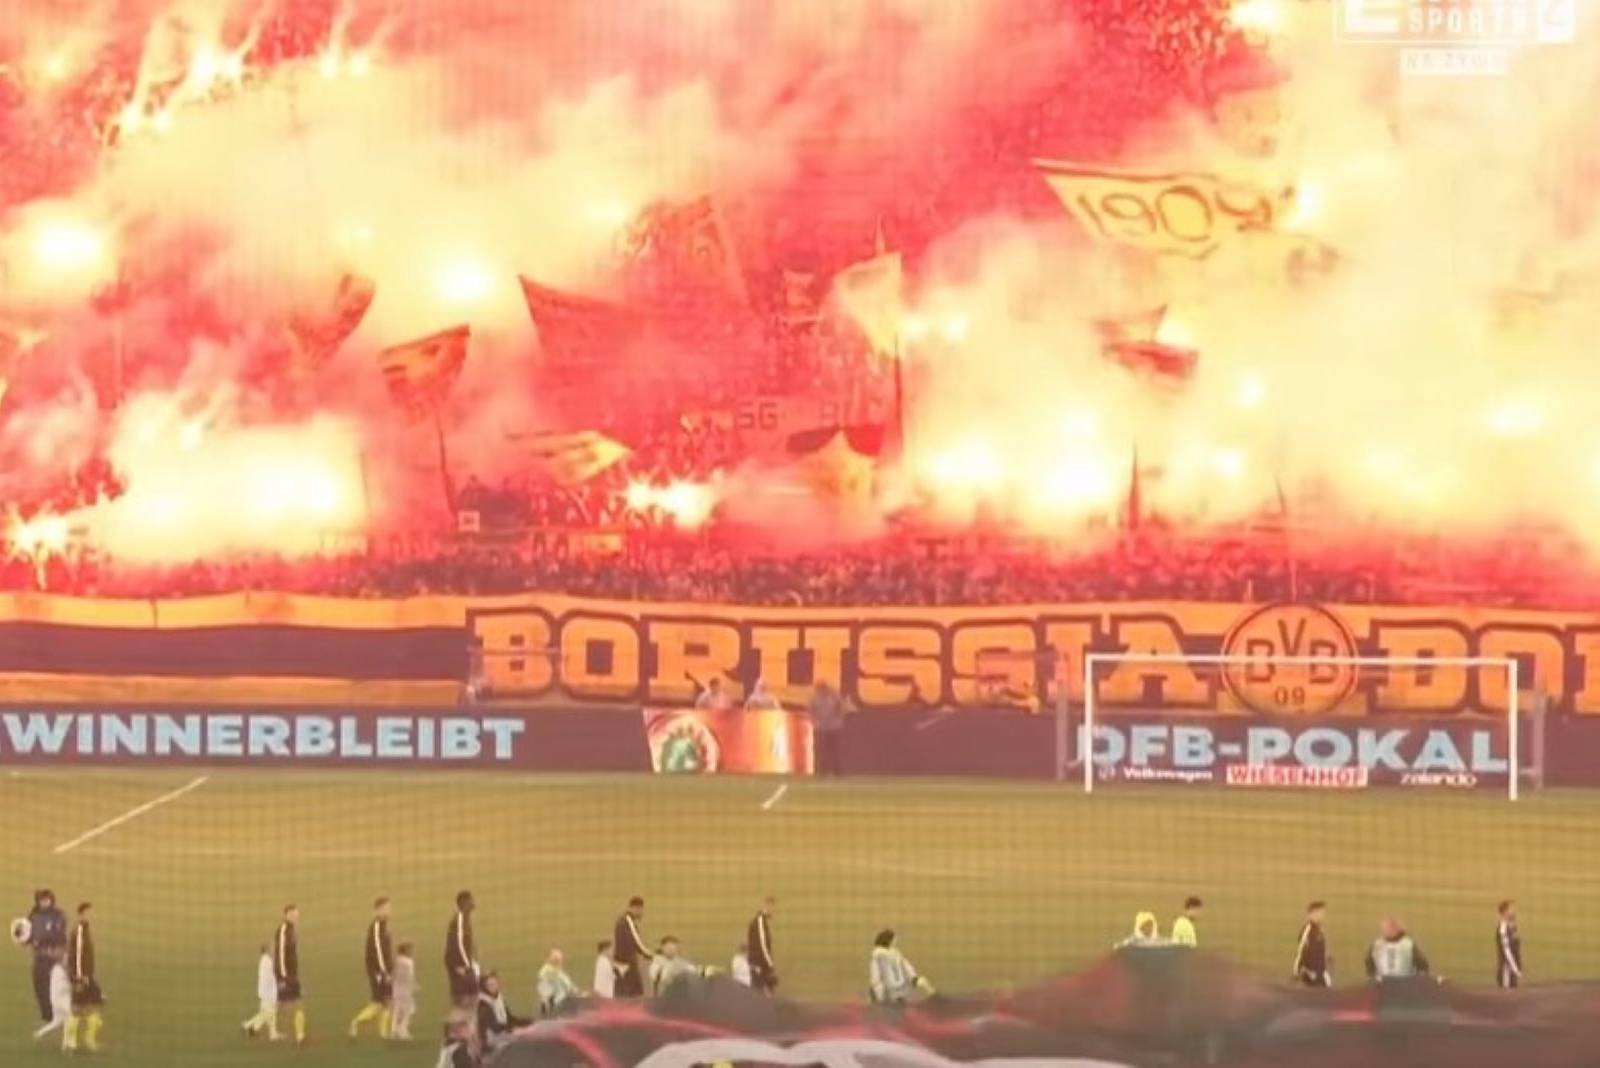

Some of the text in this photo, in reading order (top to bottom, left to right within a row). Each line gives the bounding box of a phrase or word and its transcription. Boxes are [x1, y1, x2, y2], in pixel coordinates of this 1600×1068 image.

[468, 609, 1211, 708] BORUSSIA
[1246, 618, 1340, 684] BVB
[1274, 686, 1306, 705] 09
[2, 712, 526, 760] WINNERBLEIBT
[1076, 724, 1508, 773] DFB-POKAL
[1228, 766, 1366, 786] WIESENHOF
